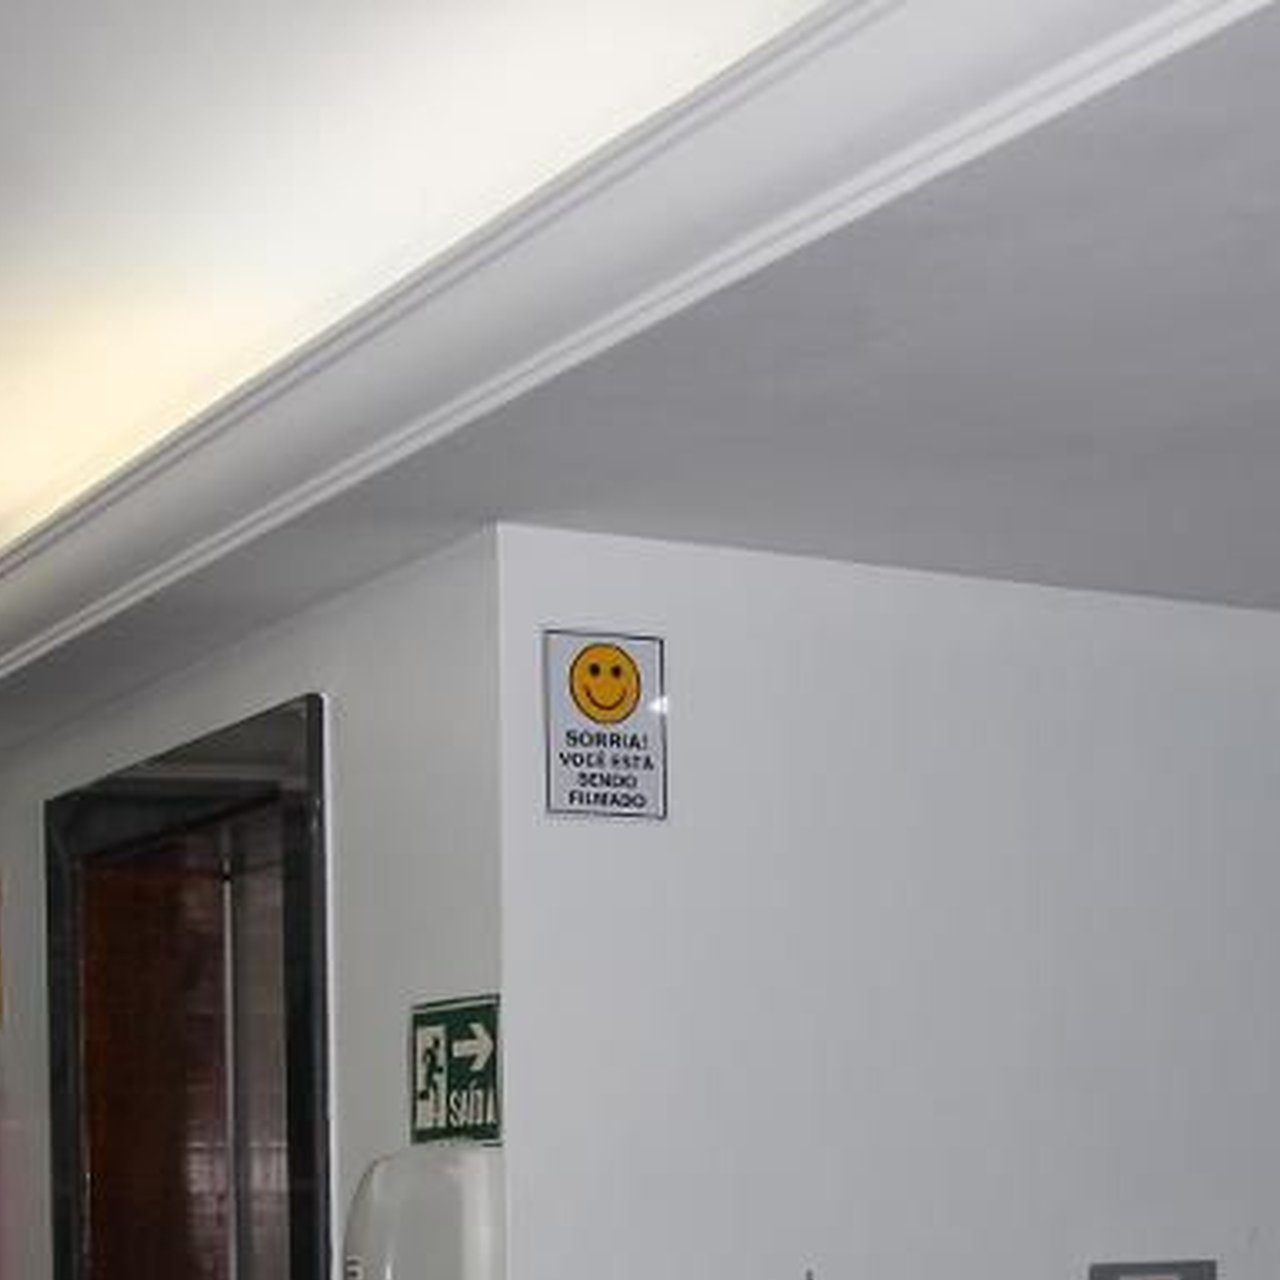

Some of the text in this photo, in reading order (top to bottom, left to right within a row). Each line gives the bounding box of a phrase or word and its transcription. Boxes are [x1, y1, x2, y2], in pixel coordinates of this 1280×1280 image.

[565, 729, 648, 750] SORRIA!
[577, 772, 638, 789] SENDO
[568, 789, 647, 809] FILMADO
